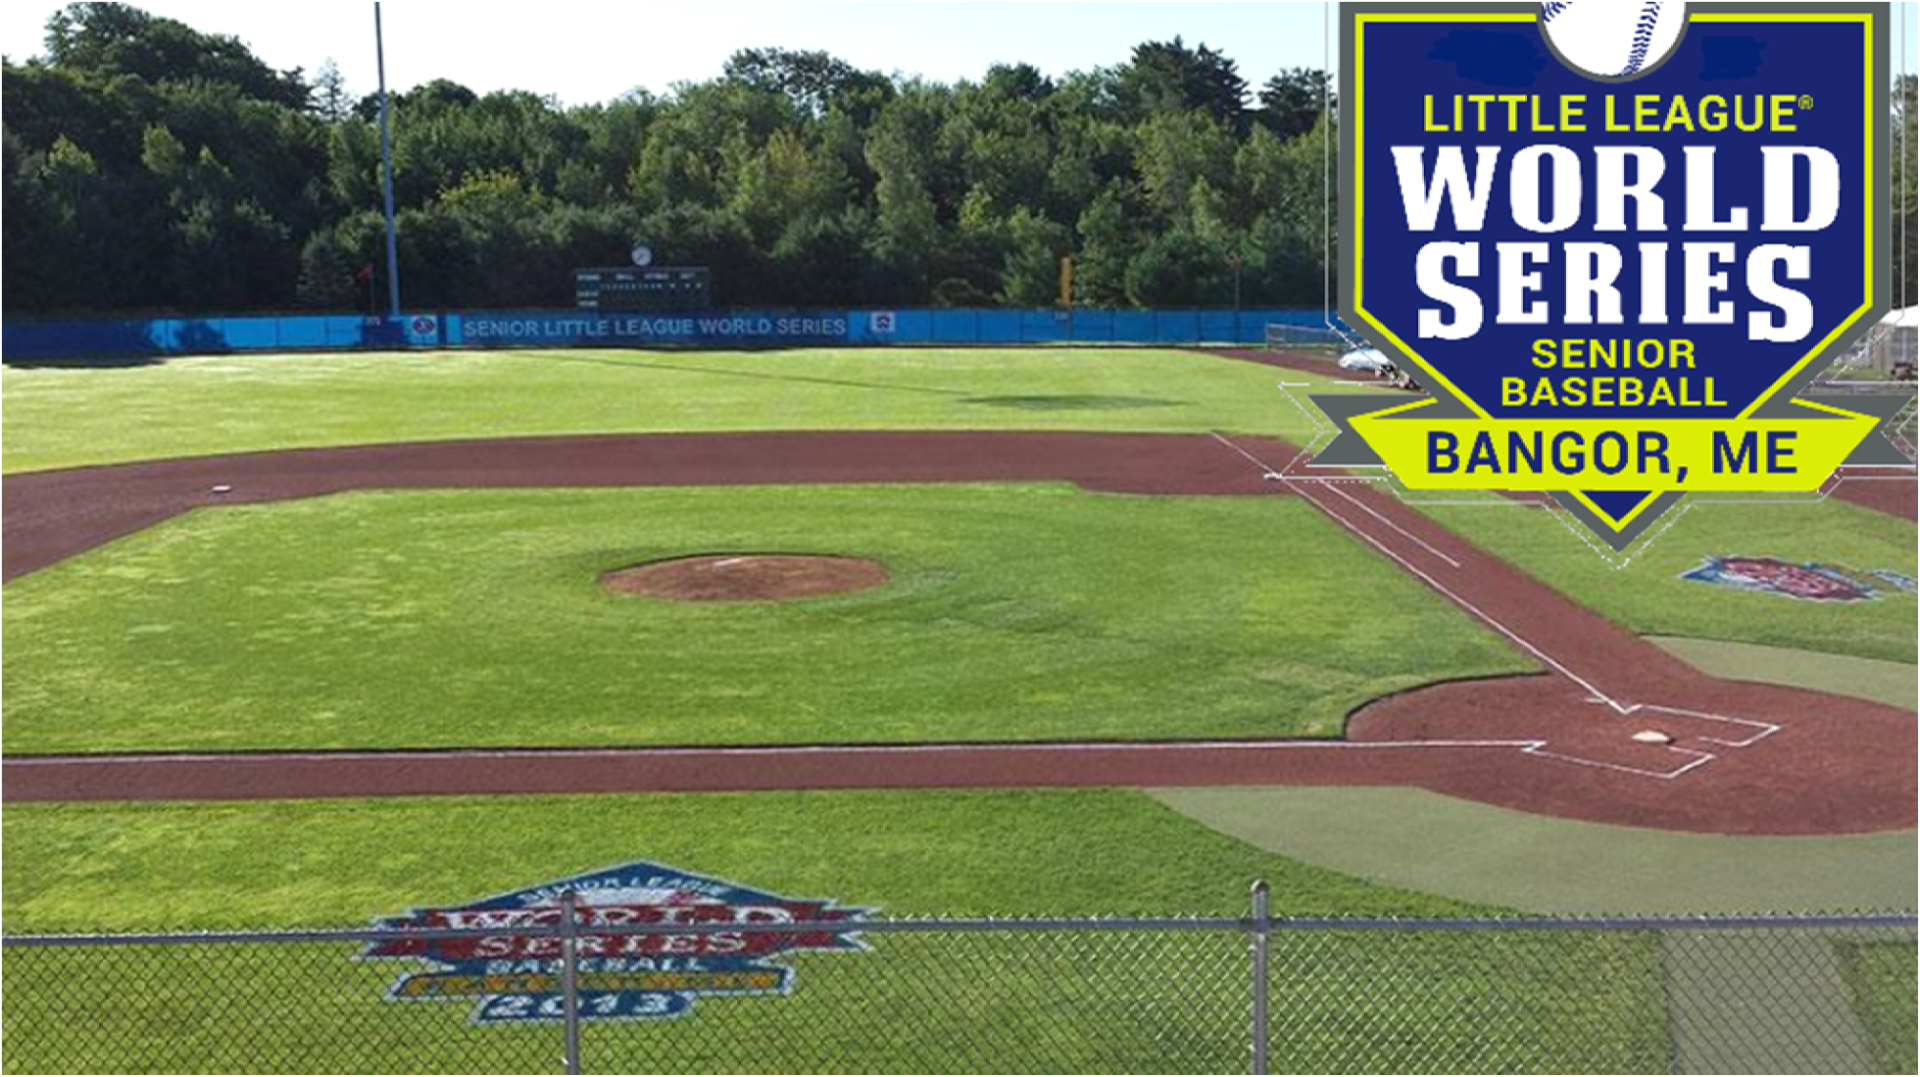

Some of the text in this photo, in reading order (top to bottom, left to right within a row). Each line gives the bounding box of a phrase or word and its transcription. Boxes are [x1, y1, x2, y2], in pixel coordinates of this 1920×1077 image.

[464, 318, 846, 337] SENIOR LITTLE LEAGUE WORLD SERIES
[516, 876, 732, 901] SENIOR LEAGUE
[472, 931, 747, 957] SERIES
[485, 957, 709, 974] BASEBALL
[487, 993, 669, 1017] 2013
